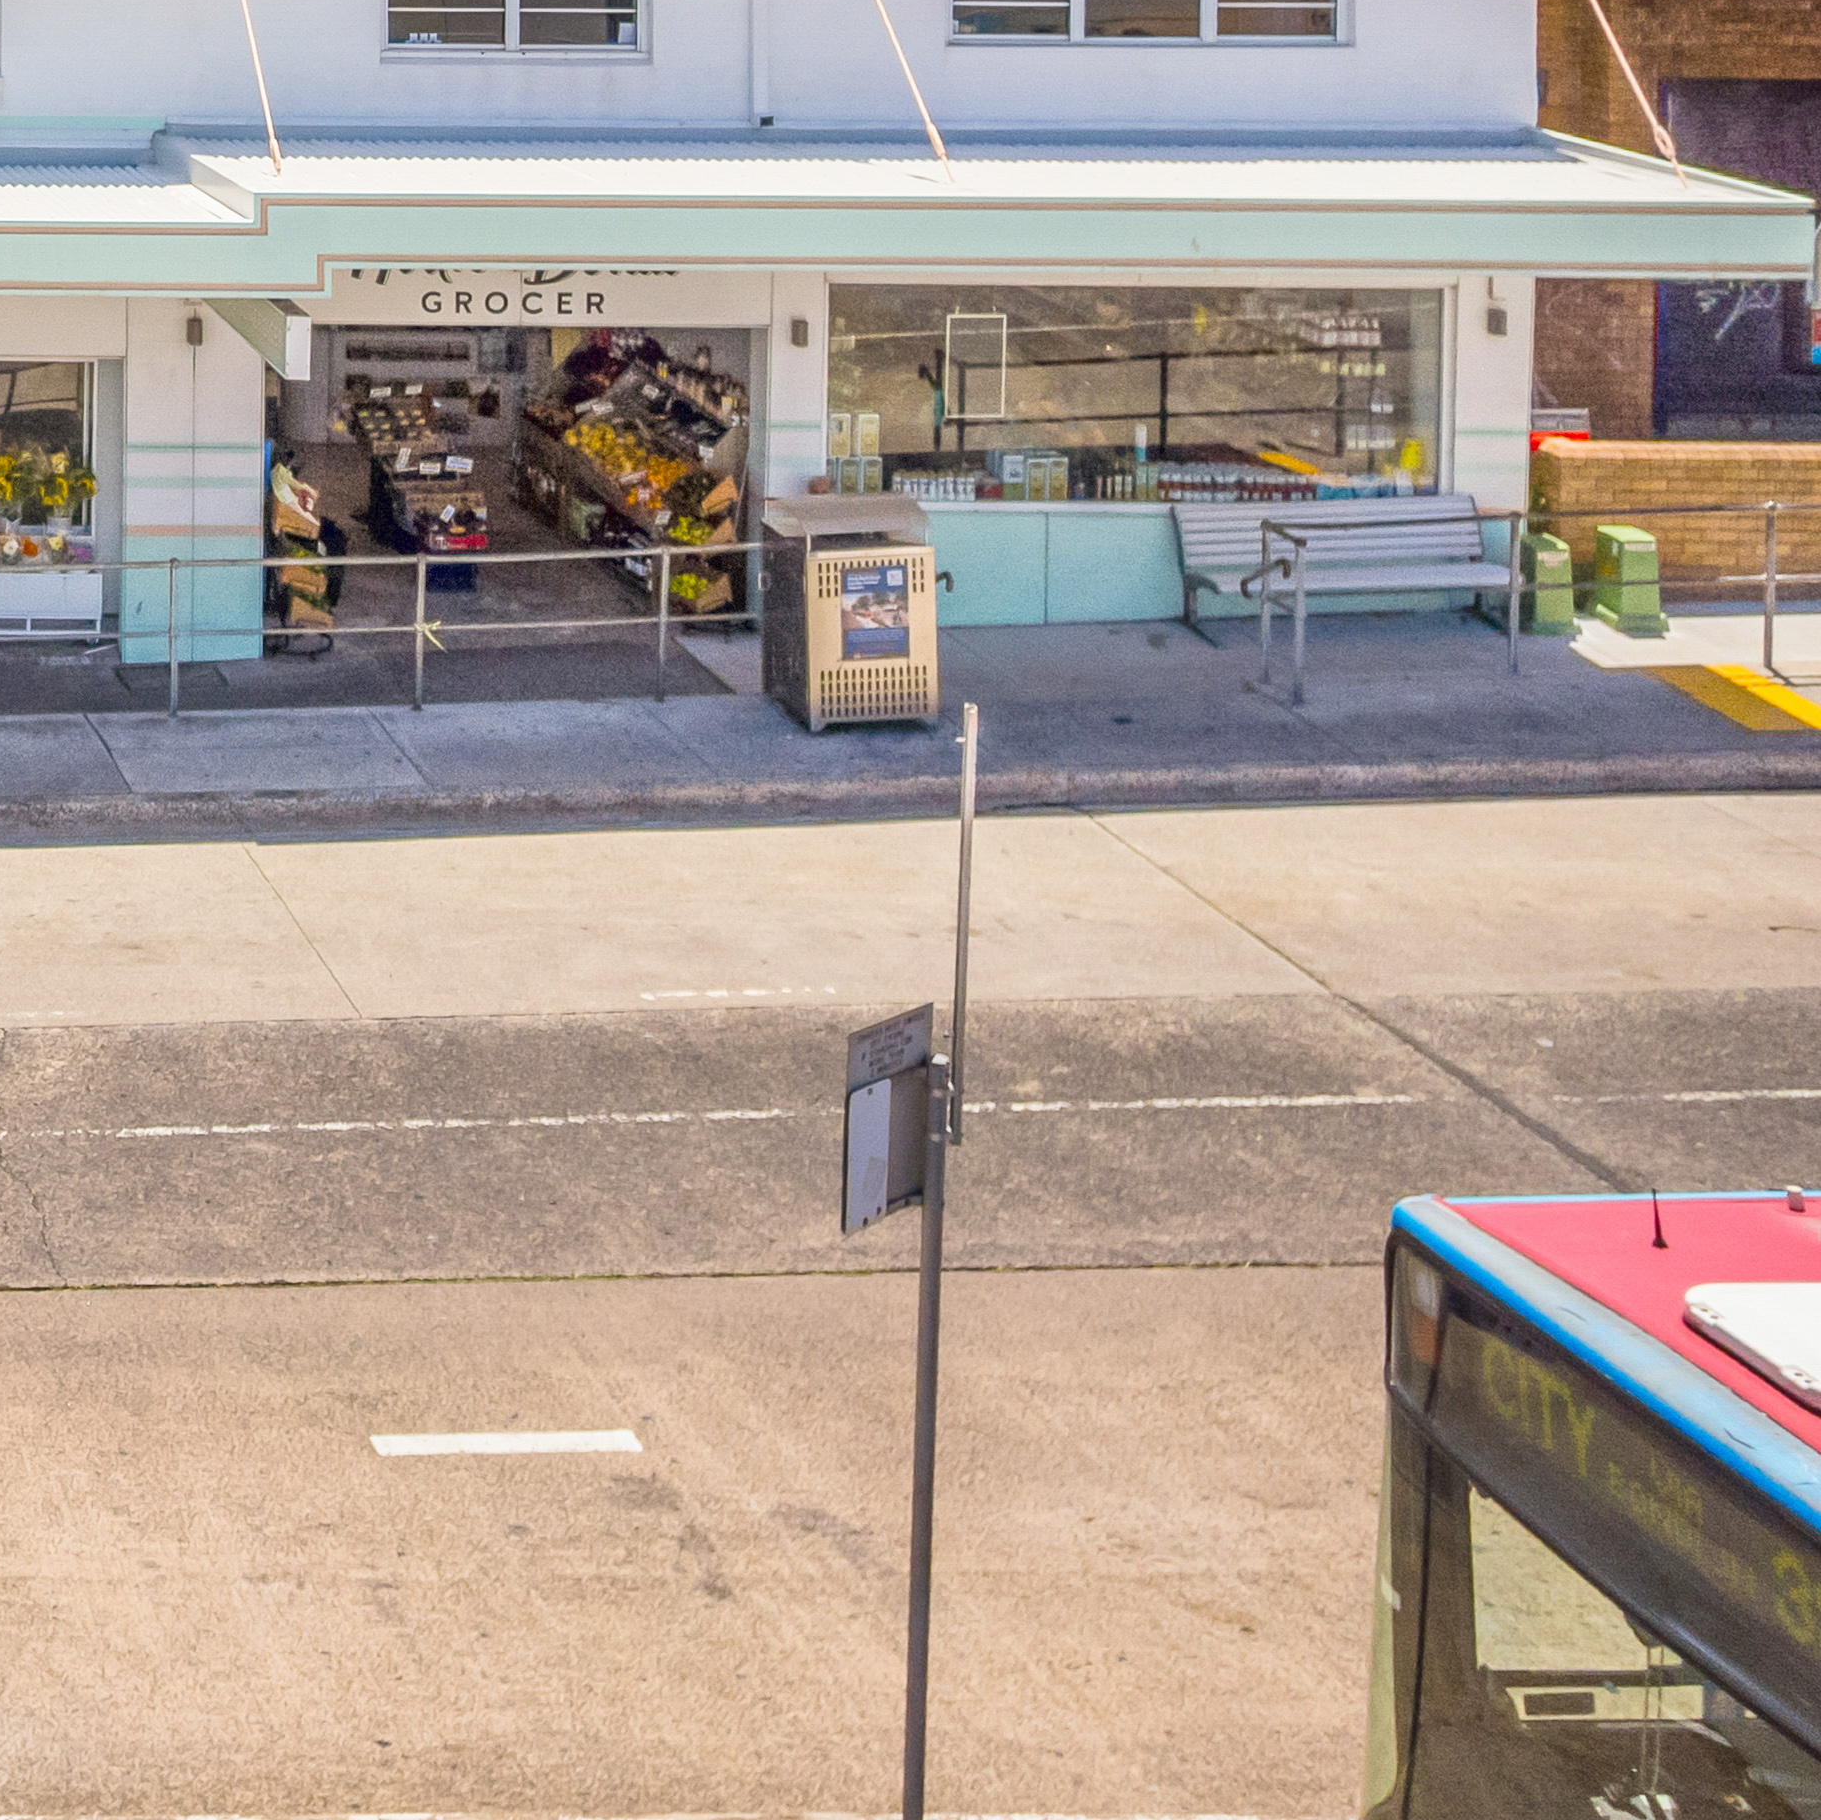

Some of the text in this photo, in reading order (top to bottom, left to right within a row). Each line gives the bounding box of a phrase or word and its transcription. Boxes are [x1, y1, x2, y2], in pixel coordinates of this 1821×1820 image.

[421, 291, 606, 314] GROCER
[1482, 1338, 1595, 1478] CITY
[1771, 1548, 1821, 1650] 3
